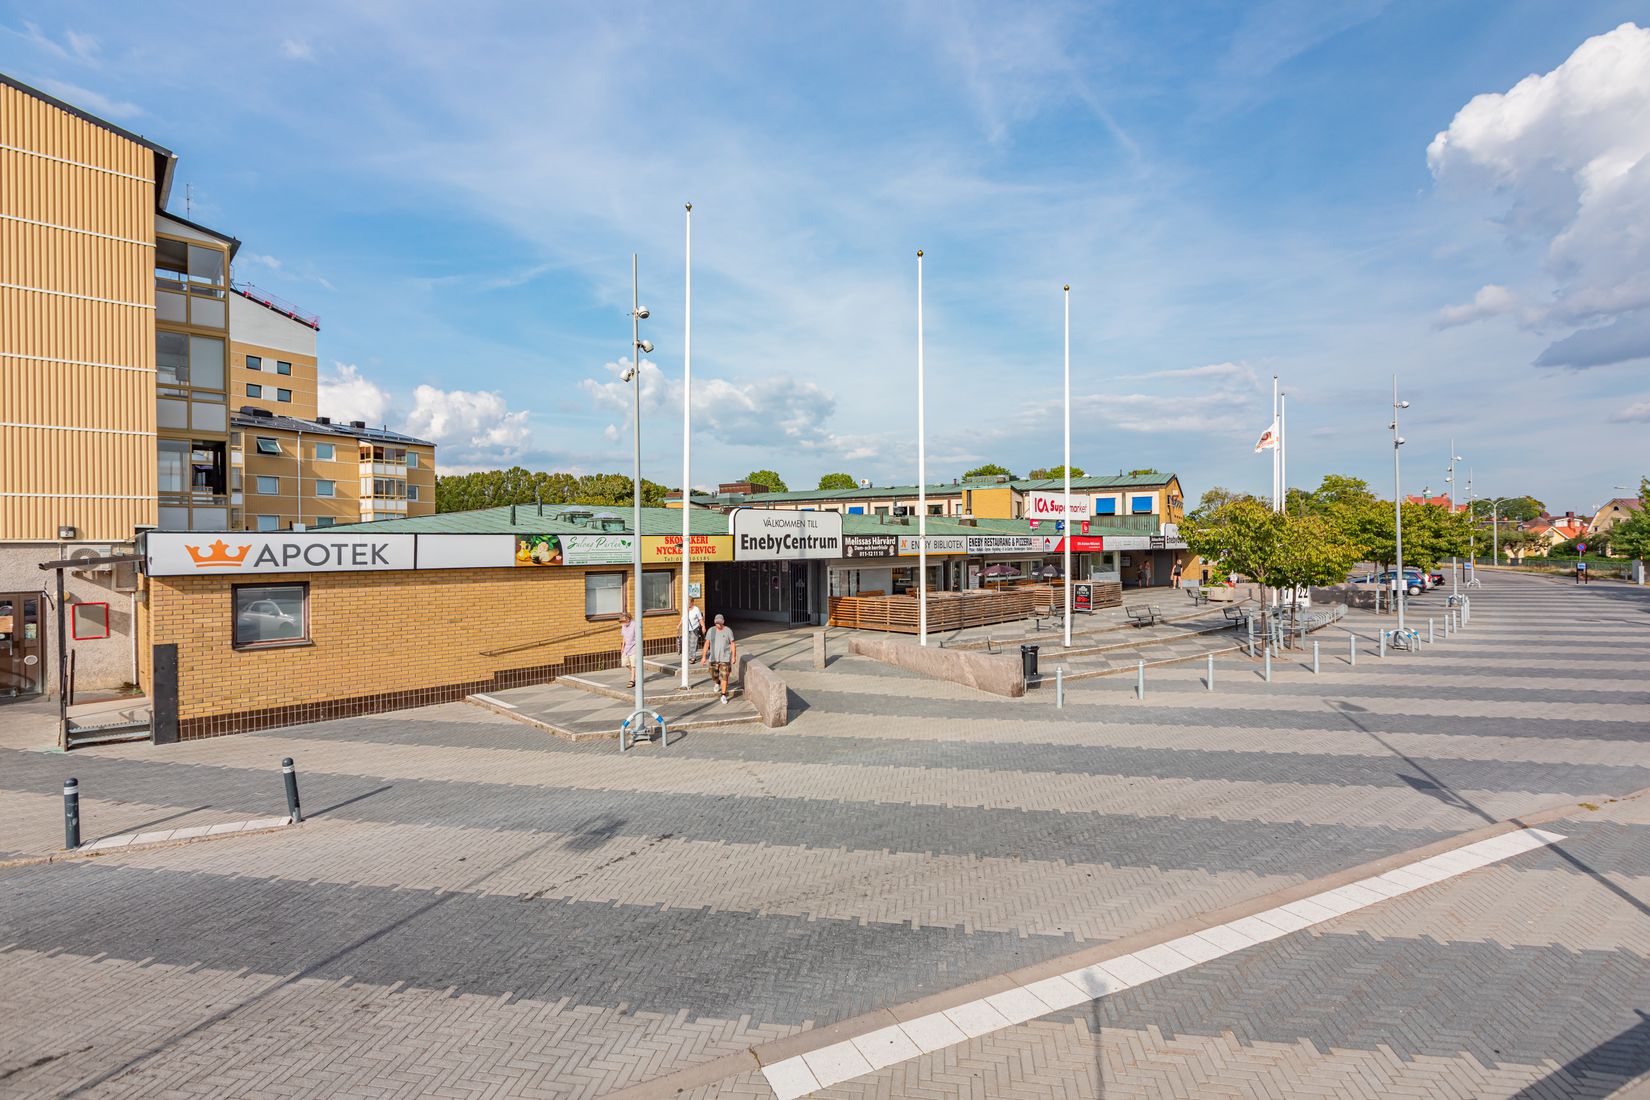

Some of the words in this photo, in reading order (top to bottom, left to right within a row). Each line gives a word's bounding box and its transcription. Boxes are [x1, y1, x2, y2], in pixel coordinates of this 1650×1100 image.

[1034, 497, 1049, 513] ICA
[763, 517, 806, 528] VÄLKOMMEN
[808, 519, 818, 528] TILL
[741, 533, 838, 554] EnebyCentrum
[845, 537, 871, 546] Melissas
[872, 536, 896, 545] Hårvård
[934, 540, 964, 549] BIBLIOTEK
[969, 537, 983, 547] ENEBY
[984, 537, 1011, 547] RESTAURANG
[1015, 537, 1033, 546] PIZZERIA
[253, 543, 390, 568] APOTEK
[1298, 587, 1308, 599] 22
